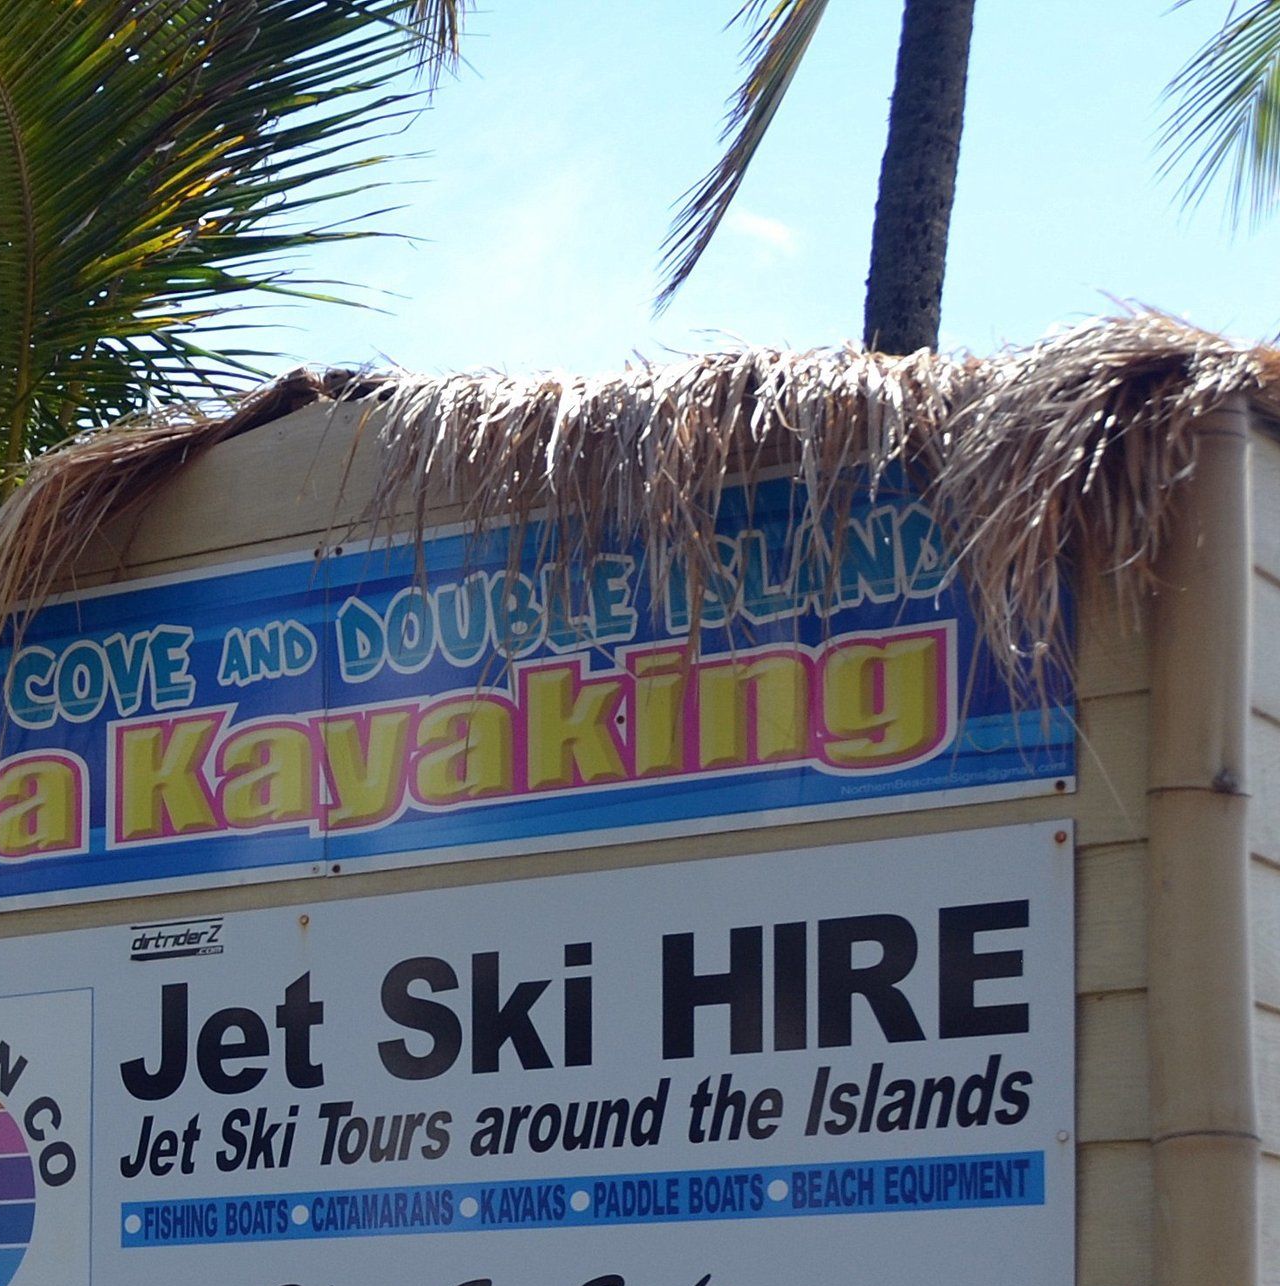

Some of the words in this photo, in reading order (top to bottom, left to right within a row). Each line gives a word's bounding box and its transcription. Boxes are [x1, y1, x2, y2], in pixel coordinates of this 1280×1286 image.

[6, 624, 197, 729] COVE
[218, 618, 318, 687] AND
[335, 553, 638, 684] DOUBLE
[664, 502, 958, 636] ISLAND
[106, 618, 959, 849] Kayaking
[120, 970, 324, 1101] Jet
[377, 943, 592, 1081] Ski
[662, 899, 1029, 1060] HIRE
[24, 1096, 77, 1188] CO
[120, 1112, 200, 1178] Jet
[216, 1104, 300, 1172] Ski
[318, 1101, 452, 1166] Tours
[470, 1077, 671, 1158] around
[688, 1073, 783, 1144] the
[804, 1054, 1033, 1136] Islands
[144, 1204, 218, 1241] FISHING
[225, 1199, 288, 1237] BOATS
[311, 1190, 454, 1232] CATAMARANS
[481, 1184, 566, 1226] KAYAKS
[593, 1178, 679, 1218] PADDLE
[689, 1173, 764, 1214] BOATS
[791, 1168, 874, 1209] BEACH
[884, 1159, 1029, 1204] EQUIPMENT
